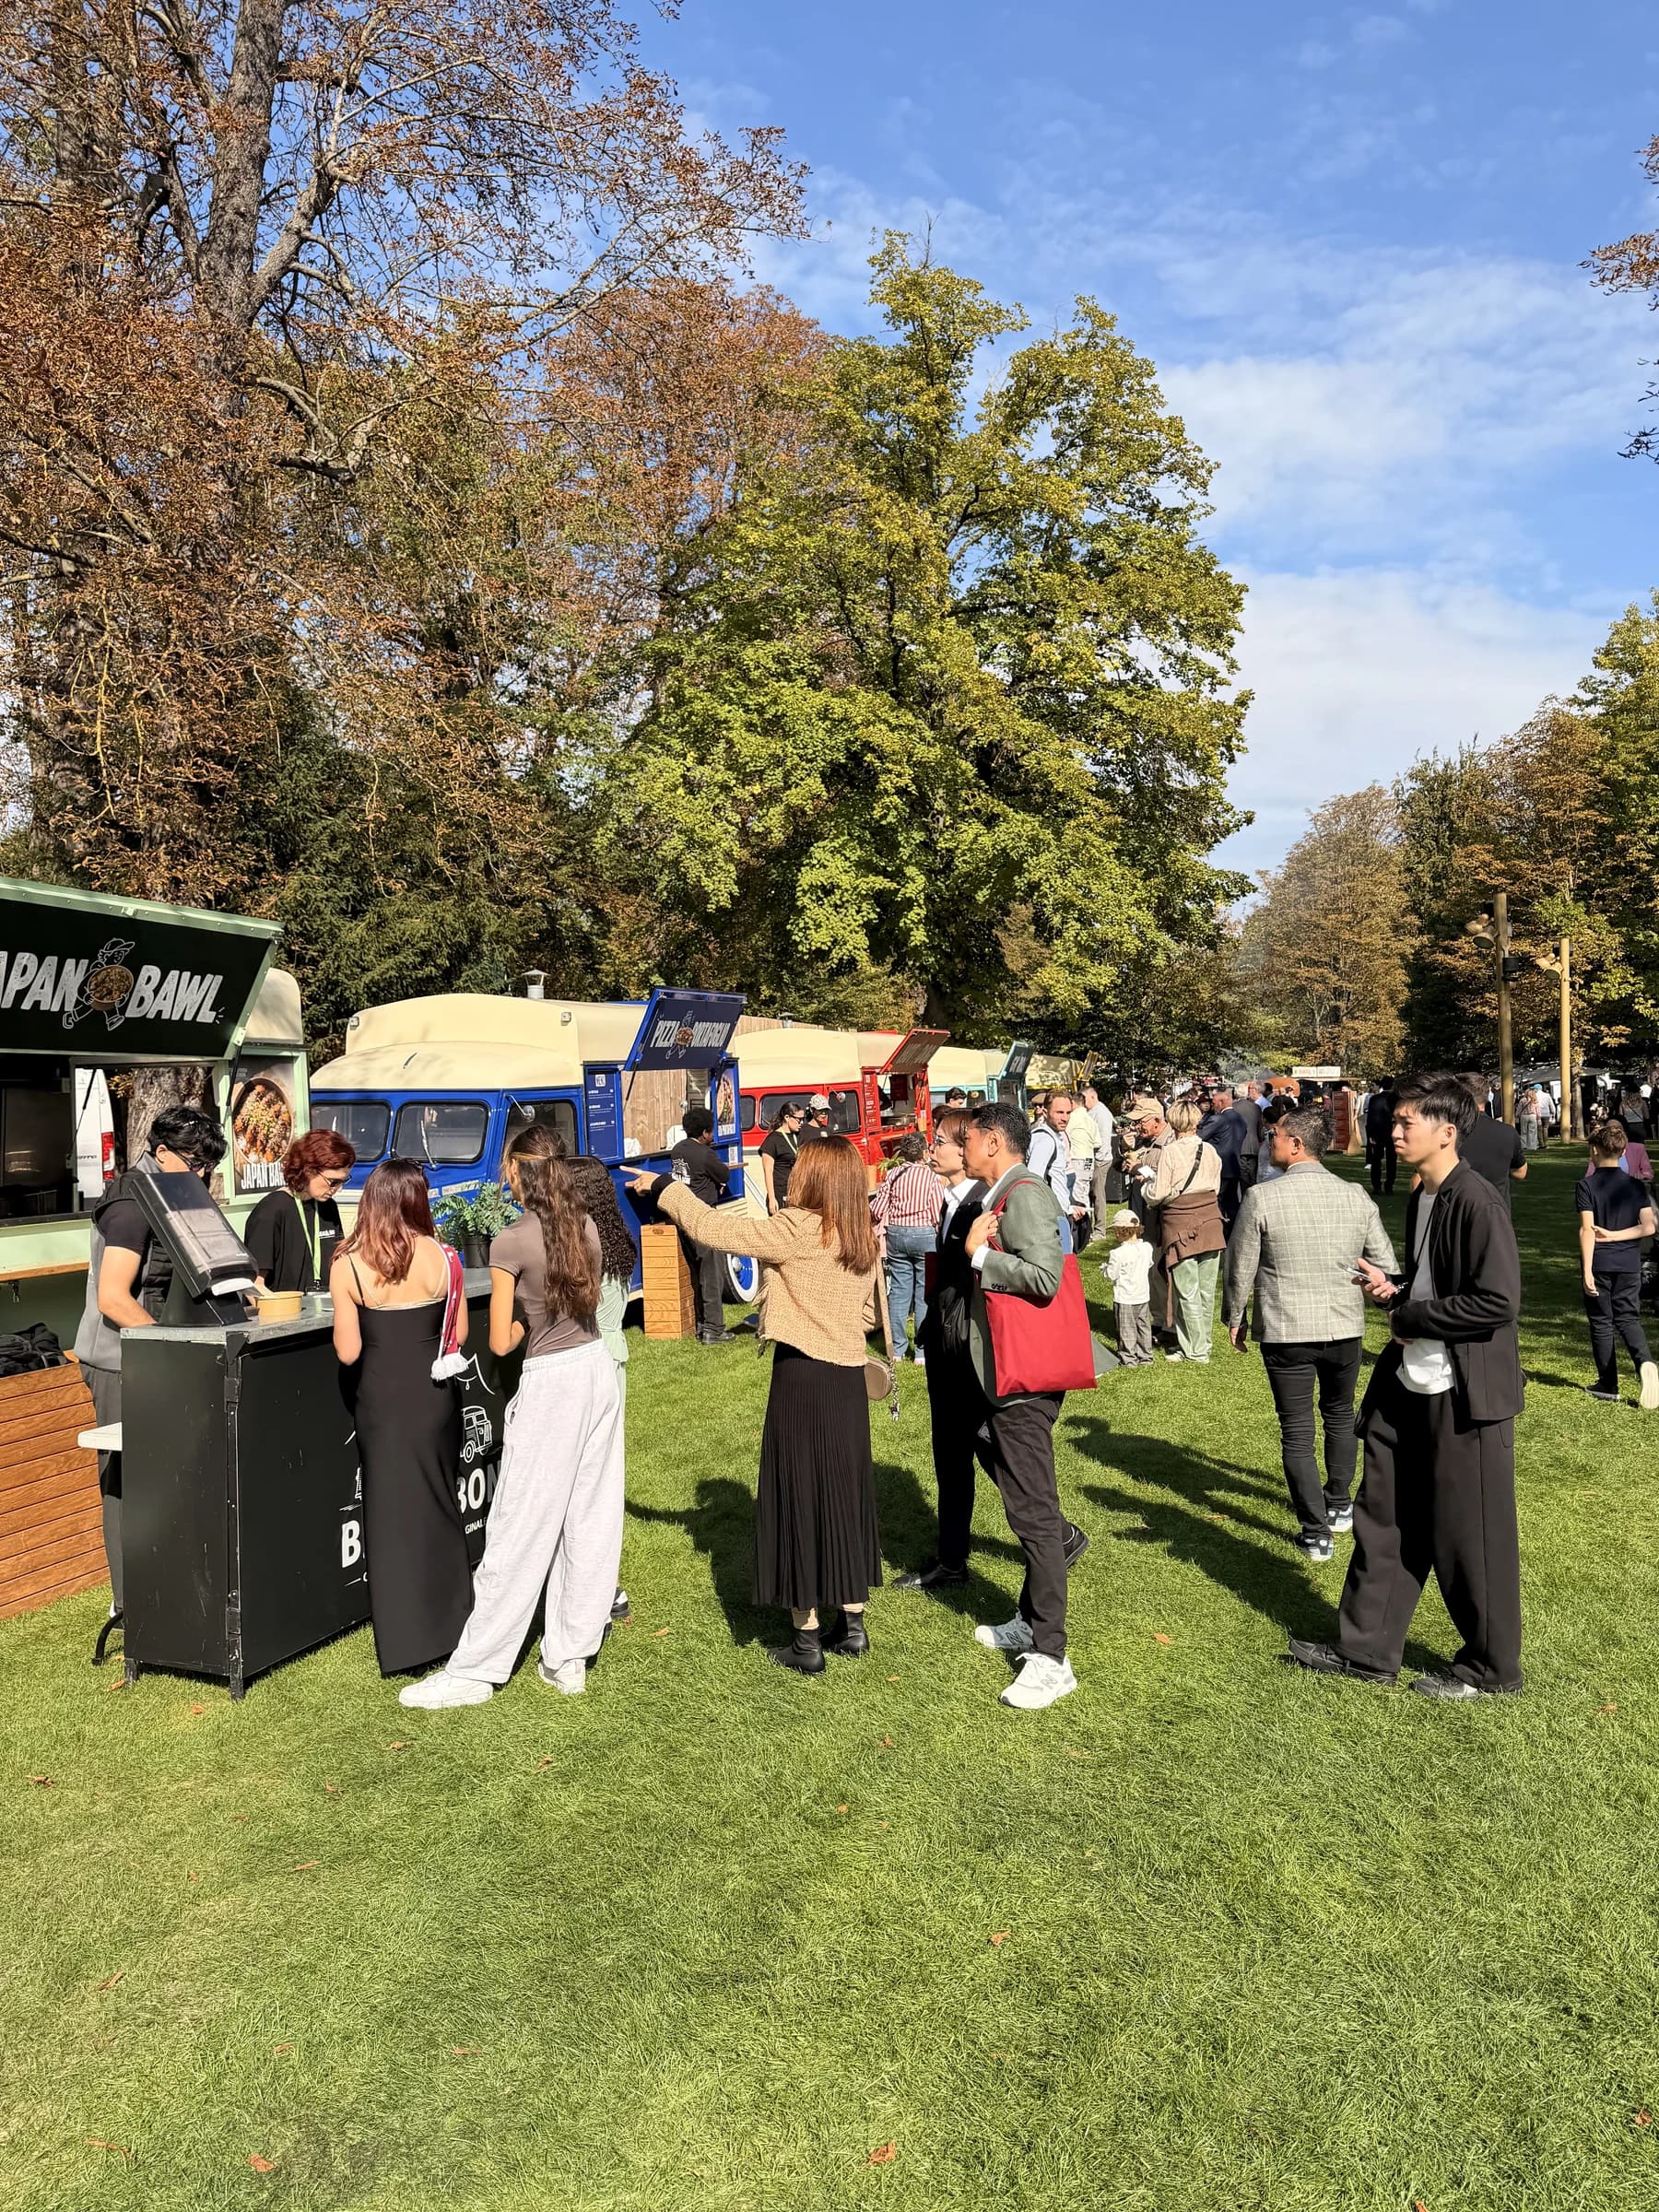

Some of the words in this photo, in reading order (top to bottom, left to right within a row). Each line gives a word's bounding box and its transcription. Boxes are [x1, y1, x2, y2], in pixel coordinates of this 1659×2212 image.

[0, 951, 89, 1012] PAN
[124, 964, 223, 1023] BAWL
[241, 1163, 268, 1190] JAPAN
[465, 1516, 488, 1535] GINALE
